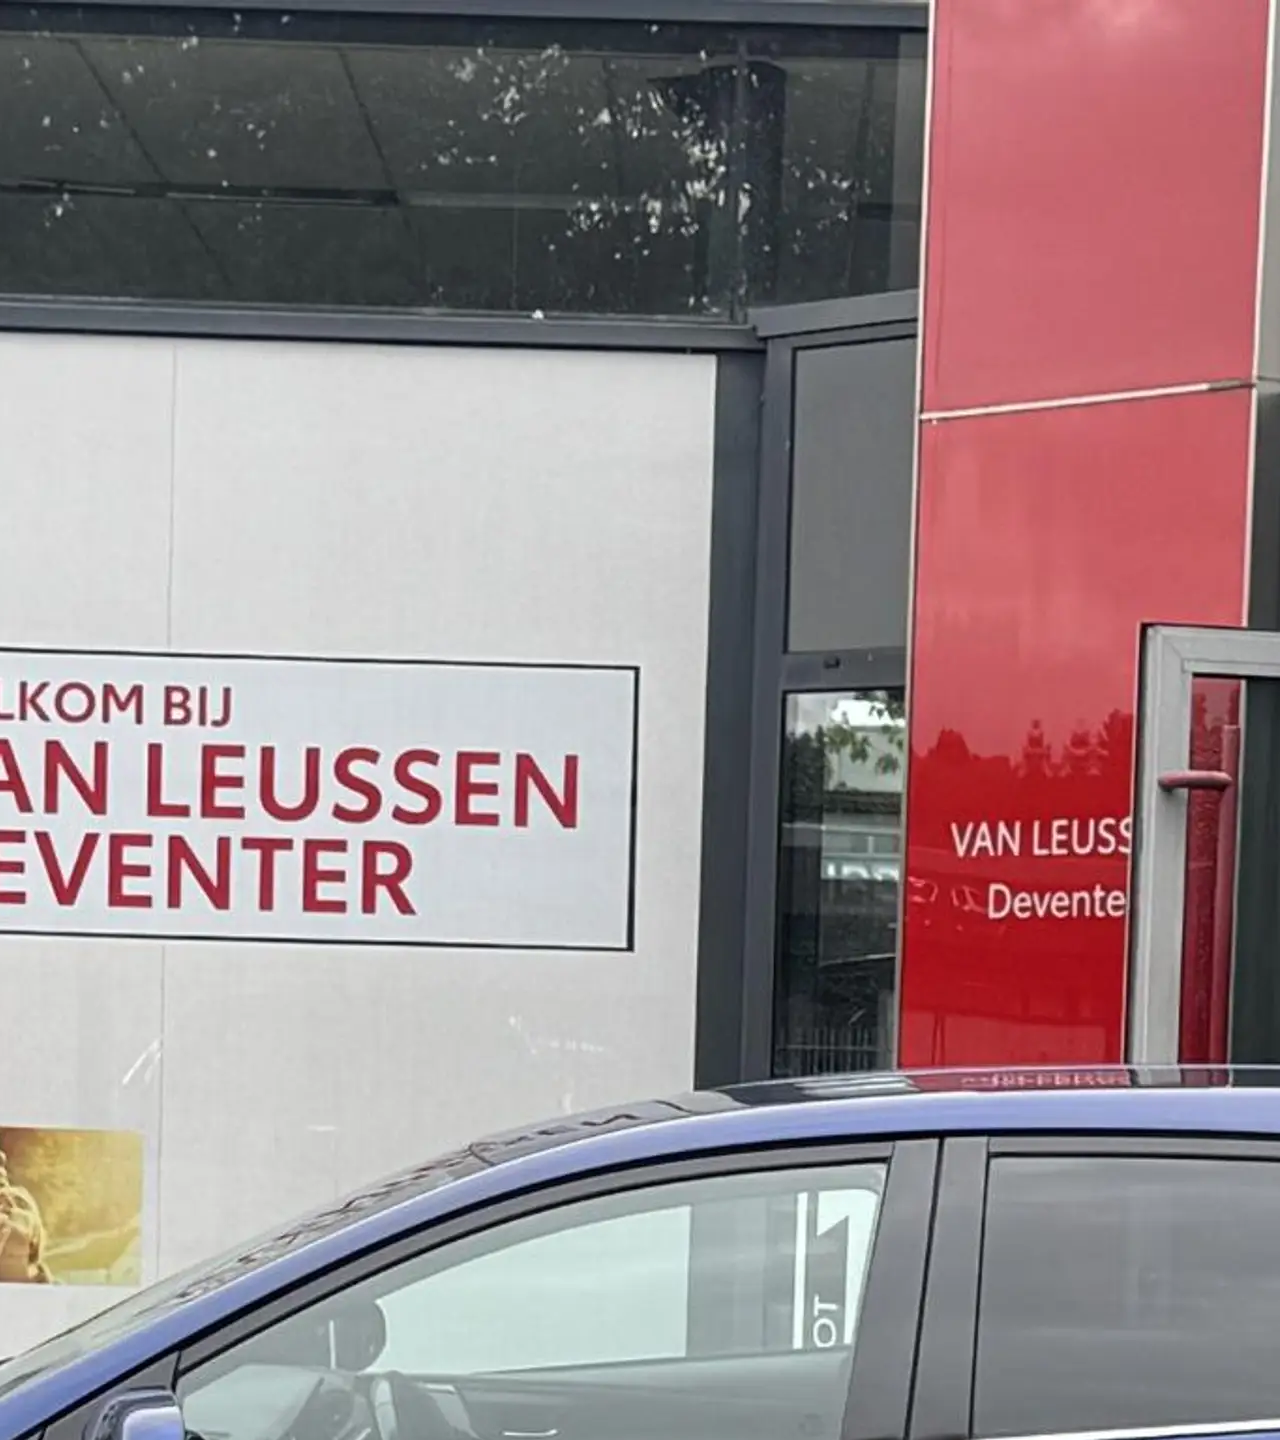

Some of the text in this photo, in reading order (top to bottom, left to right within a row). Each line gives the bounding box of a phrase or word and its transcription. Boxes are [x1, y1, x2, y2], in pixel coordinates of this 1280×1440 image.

[162, 685, 232, 728] BIJ
[146, 741, 580, 829] LEUSSEN
[951, 821, 1021, 857] VAN
[987, 882, 1129, 919] Devente
